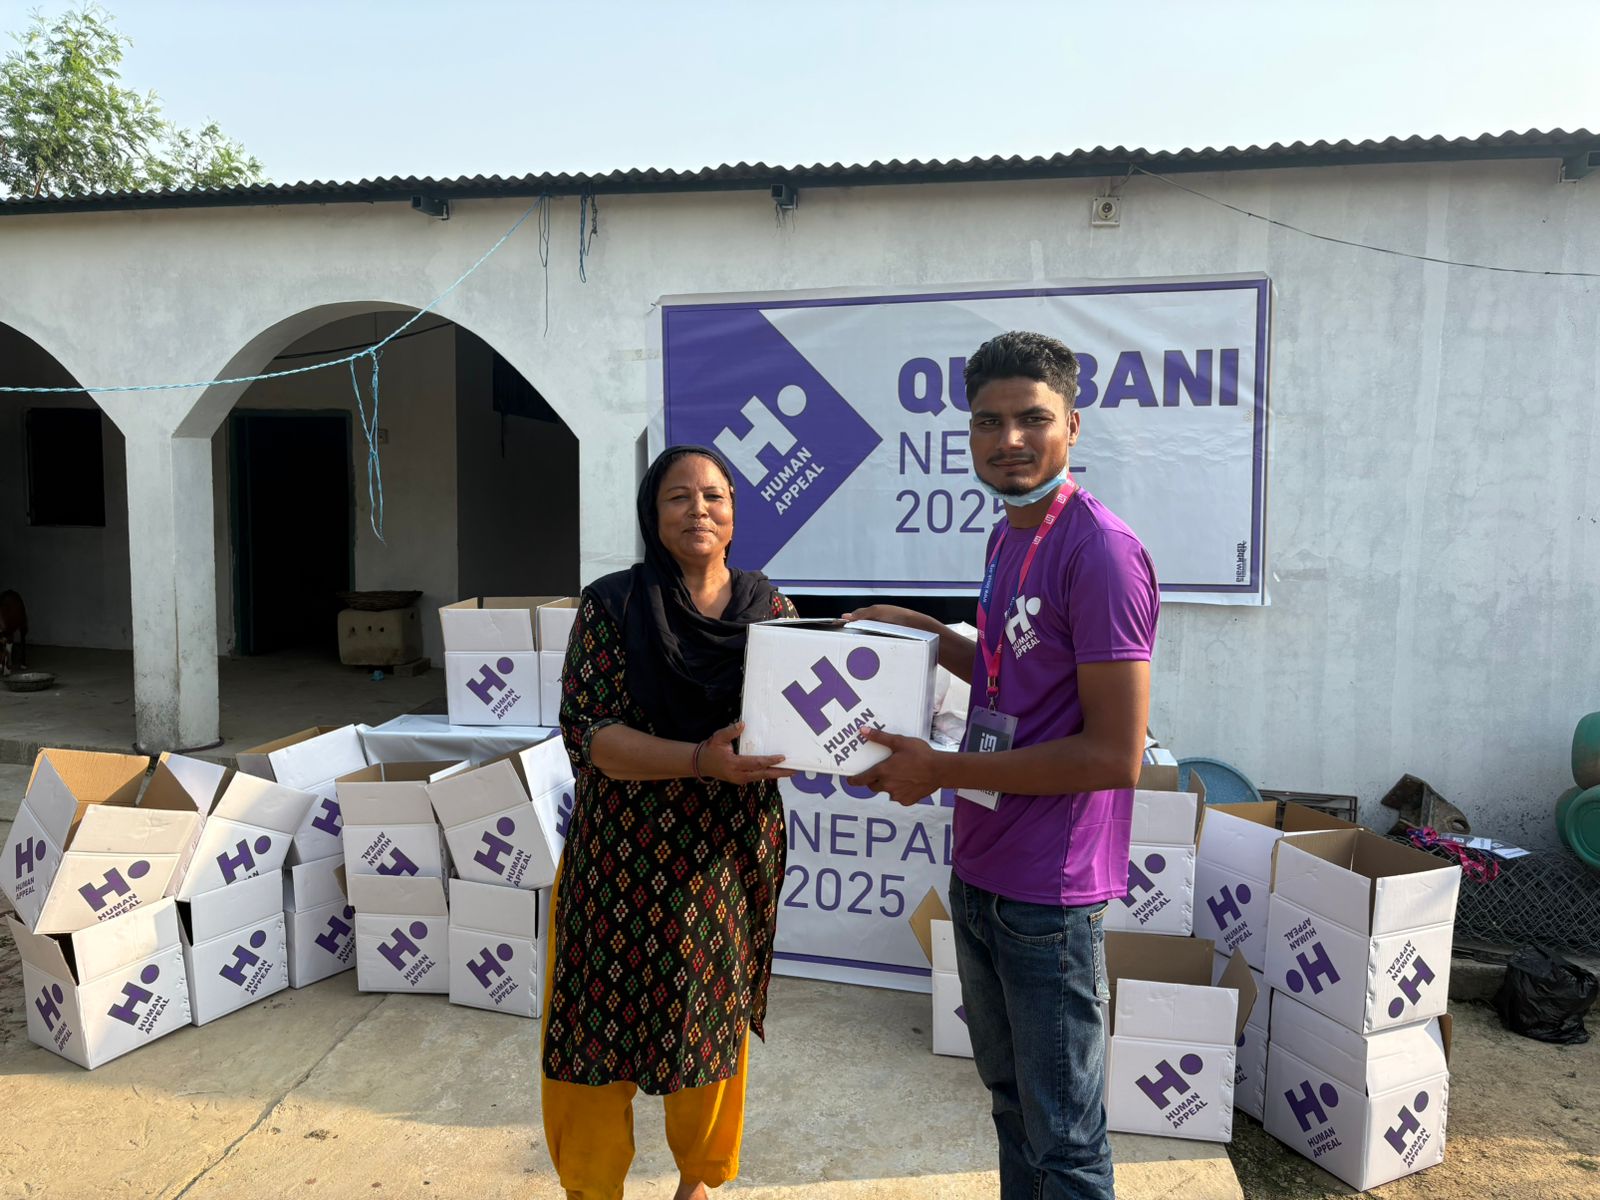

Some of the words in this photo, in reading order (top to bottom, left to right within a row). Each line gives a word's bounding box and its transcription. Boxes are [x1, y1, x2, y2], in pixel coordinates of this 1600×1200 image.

[897, 348, 1240, 417] QUBANI
[761, 447, 812, 501] HUMAN
[775, 463, 824, 515] APPEAL
[1012, 629, 1036, 652] HUMAN
[1016, 637, 1040, 660] APPEAL
[491, 688, 515, 714] HUMAN
[497, 694, 521, 720] APPEAL
[823, 708, 875, 754] HUMAN
[834, 721, 886, 766] APPEL
[360, 831, 385, 860] APPEAL
[368, 838, 392, 867] HUMAN
[506, 849, 524, 882] HUMAN
[513, 852, 532, 888] APPEAL
[16, 877, 35, 892] HUMAN
[16, 885, 35, 900] APPEAL
[784, 865, 905, 918] 2025
[97, 893, 137, 920] HUMAN
[102, 900, 143, 922] PPEAL
[1132, 890, 1164, 920] HUMAN
[1139, 896, 1171, 926] APPEAL
[1223, 921, 1248, 942] HUMAN
[1228, 929, 1253, 952] APPEAL
[1285, 917, 1312, 943] APPEAL
[1289, 927, 1317, 952] HUMAN
[404, 954, 429, 981] HUMAN
[1385, 939, 1412, 975] APPEAL
[1390, 945, 1416, 981] HUMAN
[244, 960, 267, 992] HUMAN
[250, 962, 273, 995] APPEAL
[410, 959, 436, 986] APPEAL
[489, 976, 513, 999] HUMAN
[494, 981, 518, 1006] APPEAL
[138, 995, 163, 1032] HUMAN
[145, 997, 170, 1035] APPEAL
[54, 1022, 67, 1044] HUMAN
[58, 1030, 72, 1052] APPEAL
[1165, 1092, 1201, 1122] HUMAN
[1172, 1099, 1208, 1129] APPEAL
[1307, 1127, 1336, 1148] HUMAN
[1312, 1137, 1342, 1159] APPEAL
[1402, 1128, 1428, 1164] HUMAN
[1405, 1132, 1431, 1169] APPEAL
